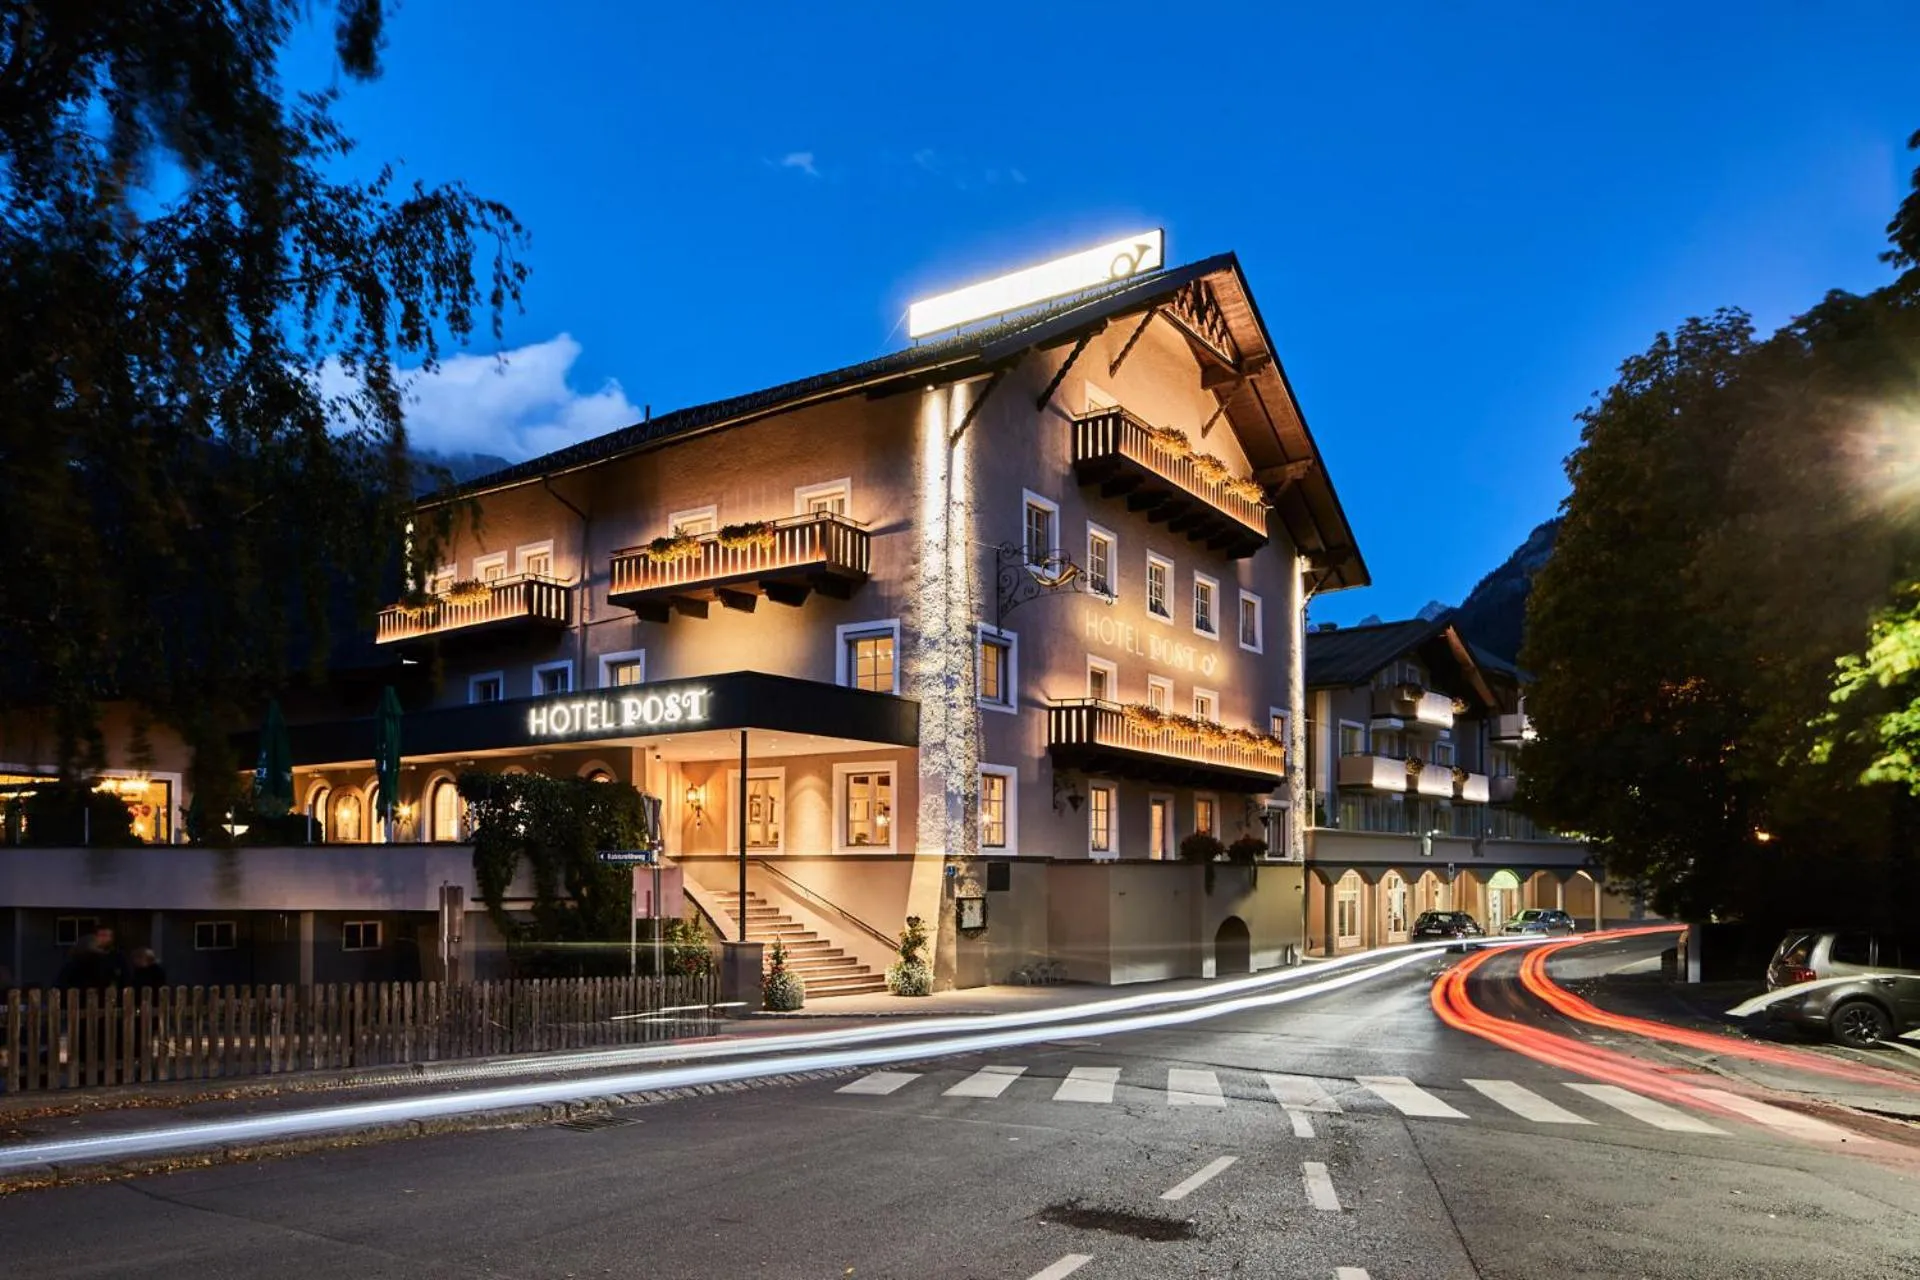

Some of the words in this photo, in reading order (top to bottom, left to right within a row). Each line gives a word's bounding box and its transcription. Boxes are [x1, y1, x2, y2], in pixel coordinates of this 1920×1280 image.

[1084, 610, 1144, 656] HOTEL
[1150, 634, 1198, 672] POST
[529, 701, 615, 736] HOTEL
[621, 688, 710, 726] POST
